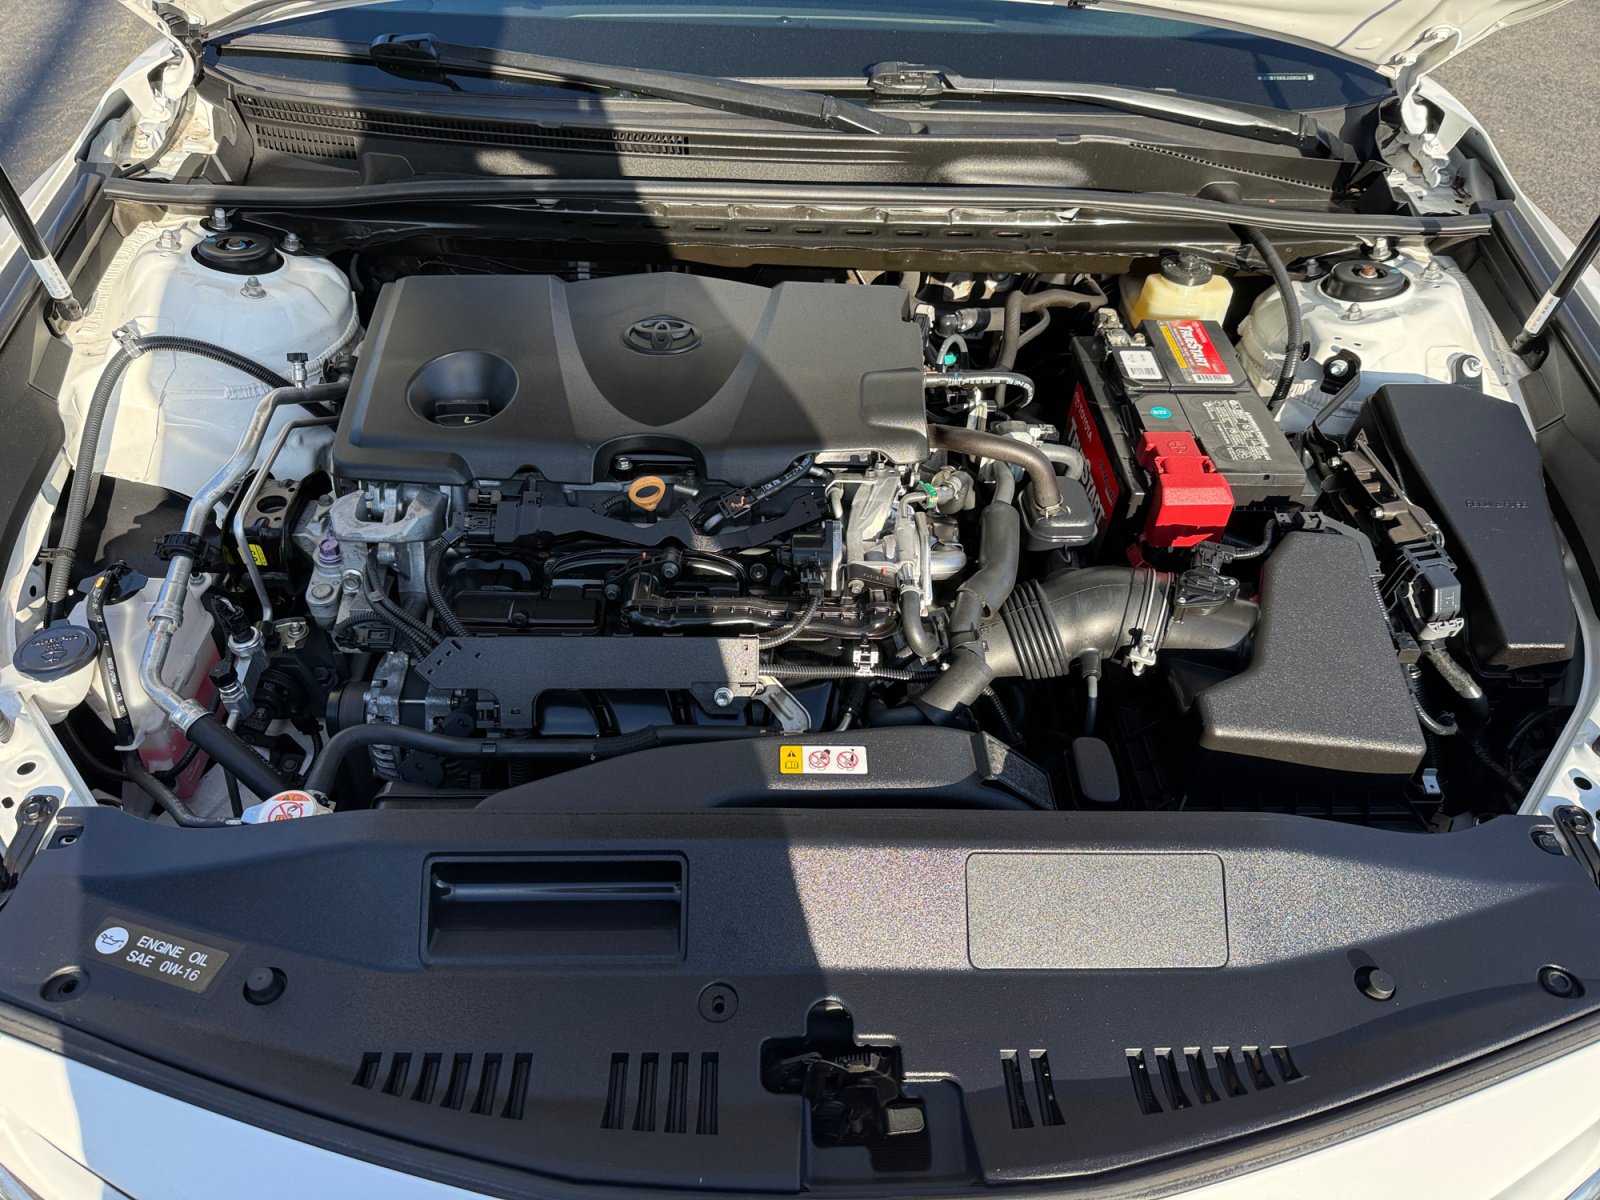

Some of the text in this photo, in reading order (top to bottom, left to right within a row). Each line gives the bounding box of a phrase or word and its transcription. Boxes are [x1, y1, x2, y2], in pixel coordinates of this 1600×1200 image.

[1077, 401, 1093, 443] TOYOTA
[126, 950, 201, 982] SAE 0W-16
[136, 935, 209, 967] ENGINE OIL
